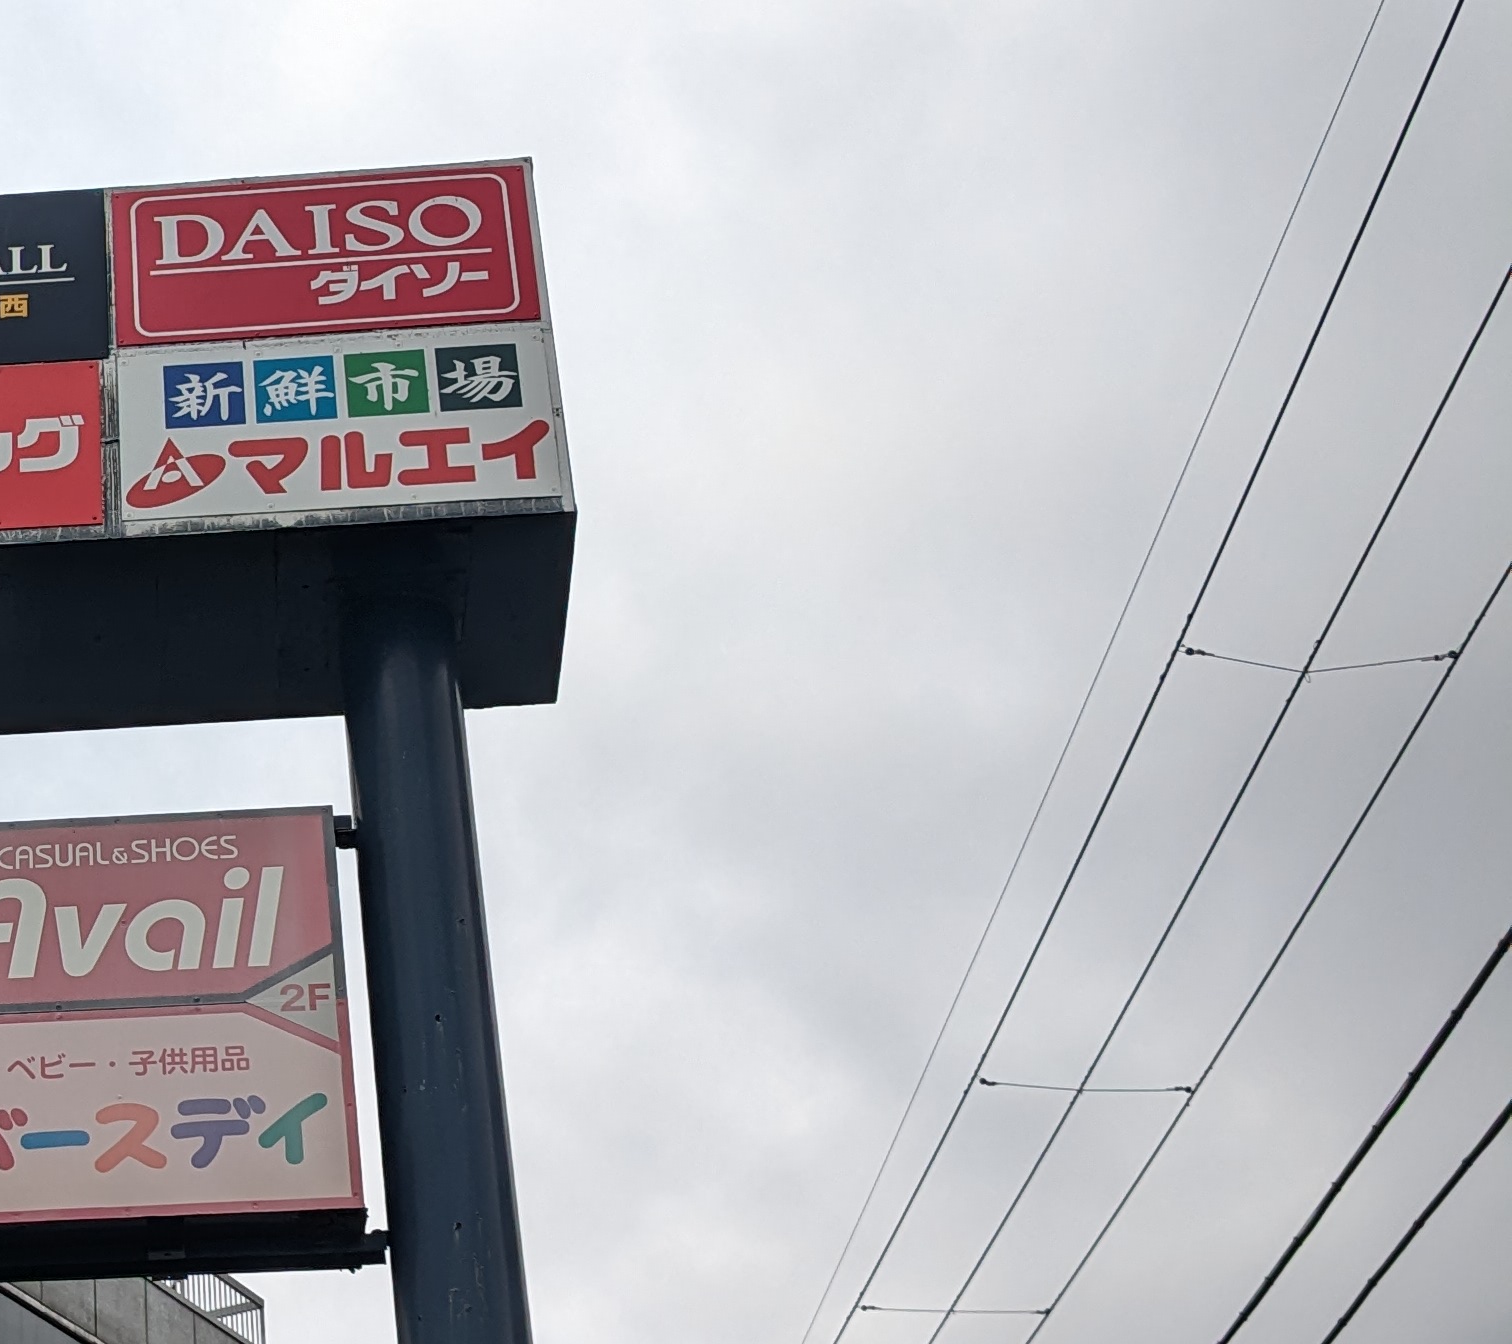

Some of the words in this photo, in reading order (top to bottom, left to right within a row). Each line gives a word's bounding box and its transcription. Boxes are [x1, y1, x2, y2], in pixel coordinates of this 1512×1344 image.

[153, 195, 482, 266] DAISO
[310, 262, 488, 305] ダイソー
[168, 355, 518, 421] 新鮮市場
[227, 419, 550, 495] マルエイ
[280, 983, 331, 1012] 2F
[7, 1045, 250, 1080] ベビー・子供用品
